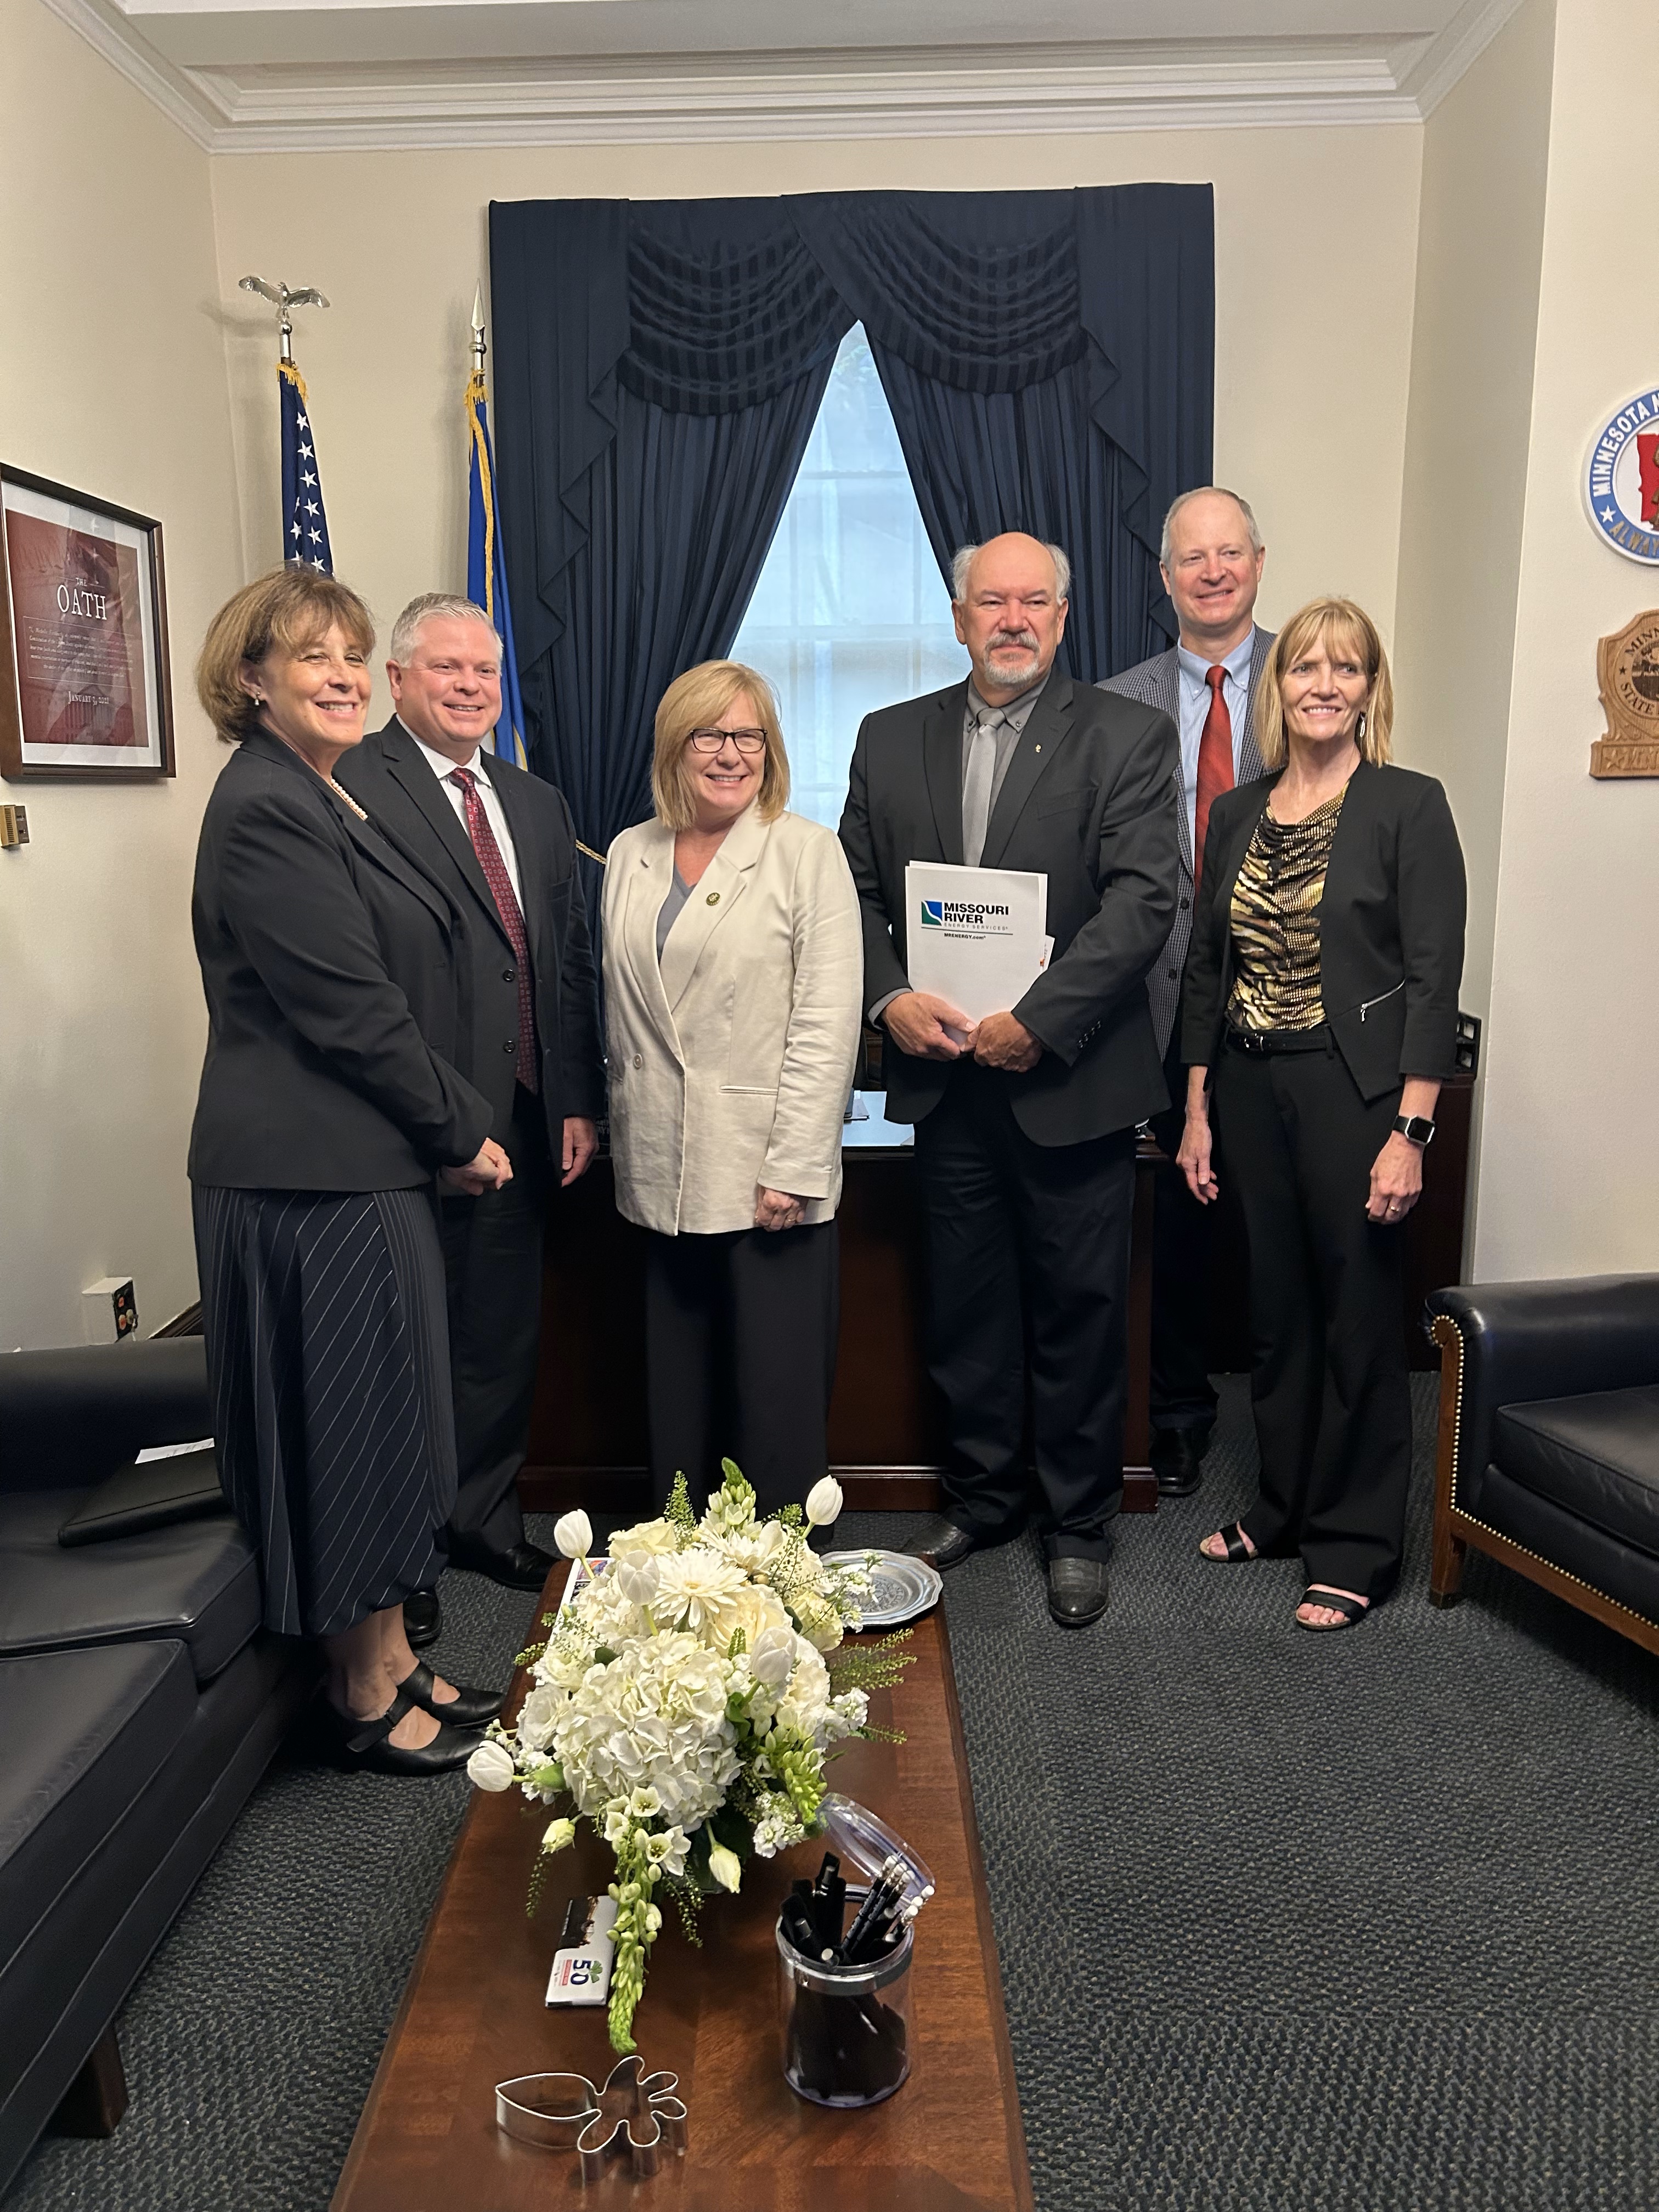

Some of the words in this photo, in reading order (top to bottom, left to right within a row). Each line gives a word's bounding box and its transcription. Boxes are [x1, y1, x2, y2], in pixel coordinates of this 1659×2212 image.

[1592, 401, 1650, 497] MINNESOTA
[76, 577, 87, 587] THE
[57, 584, 107, 620] OATH
[1621, 682, 1655, 714] STATE
[944, 902, 1009, 915] MISSOURI
[944, 912, 984, 924] RIVER
[571, 1960, 592, 1985] 50
